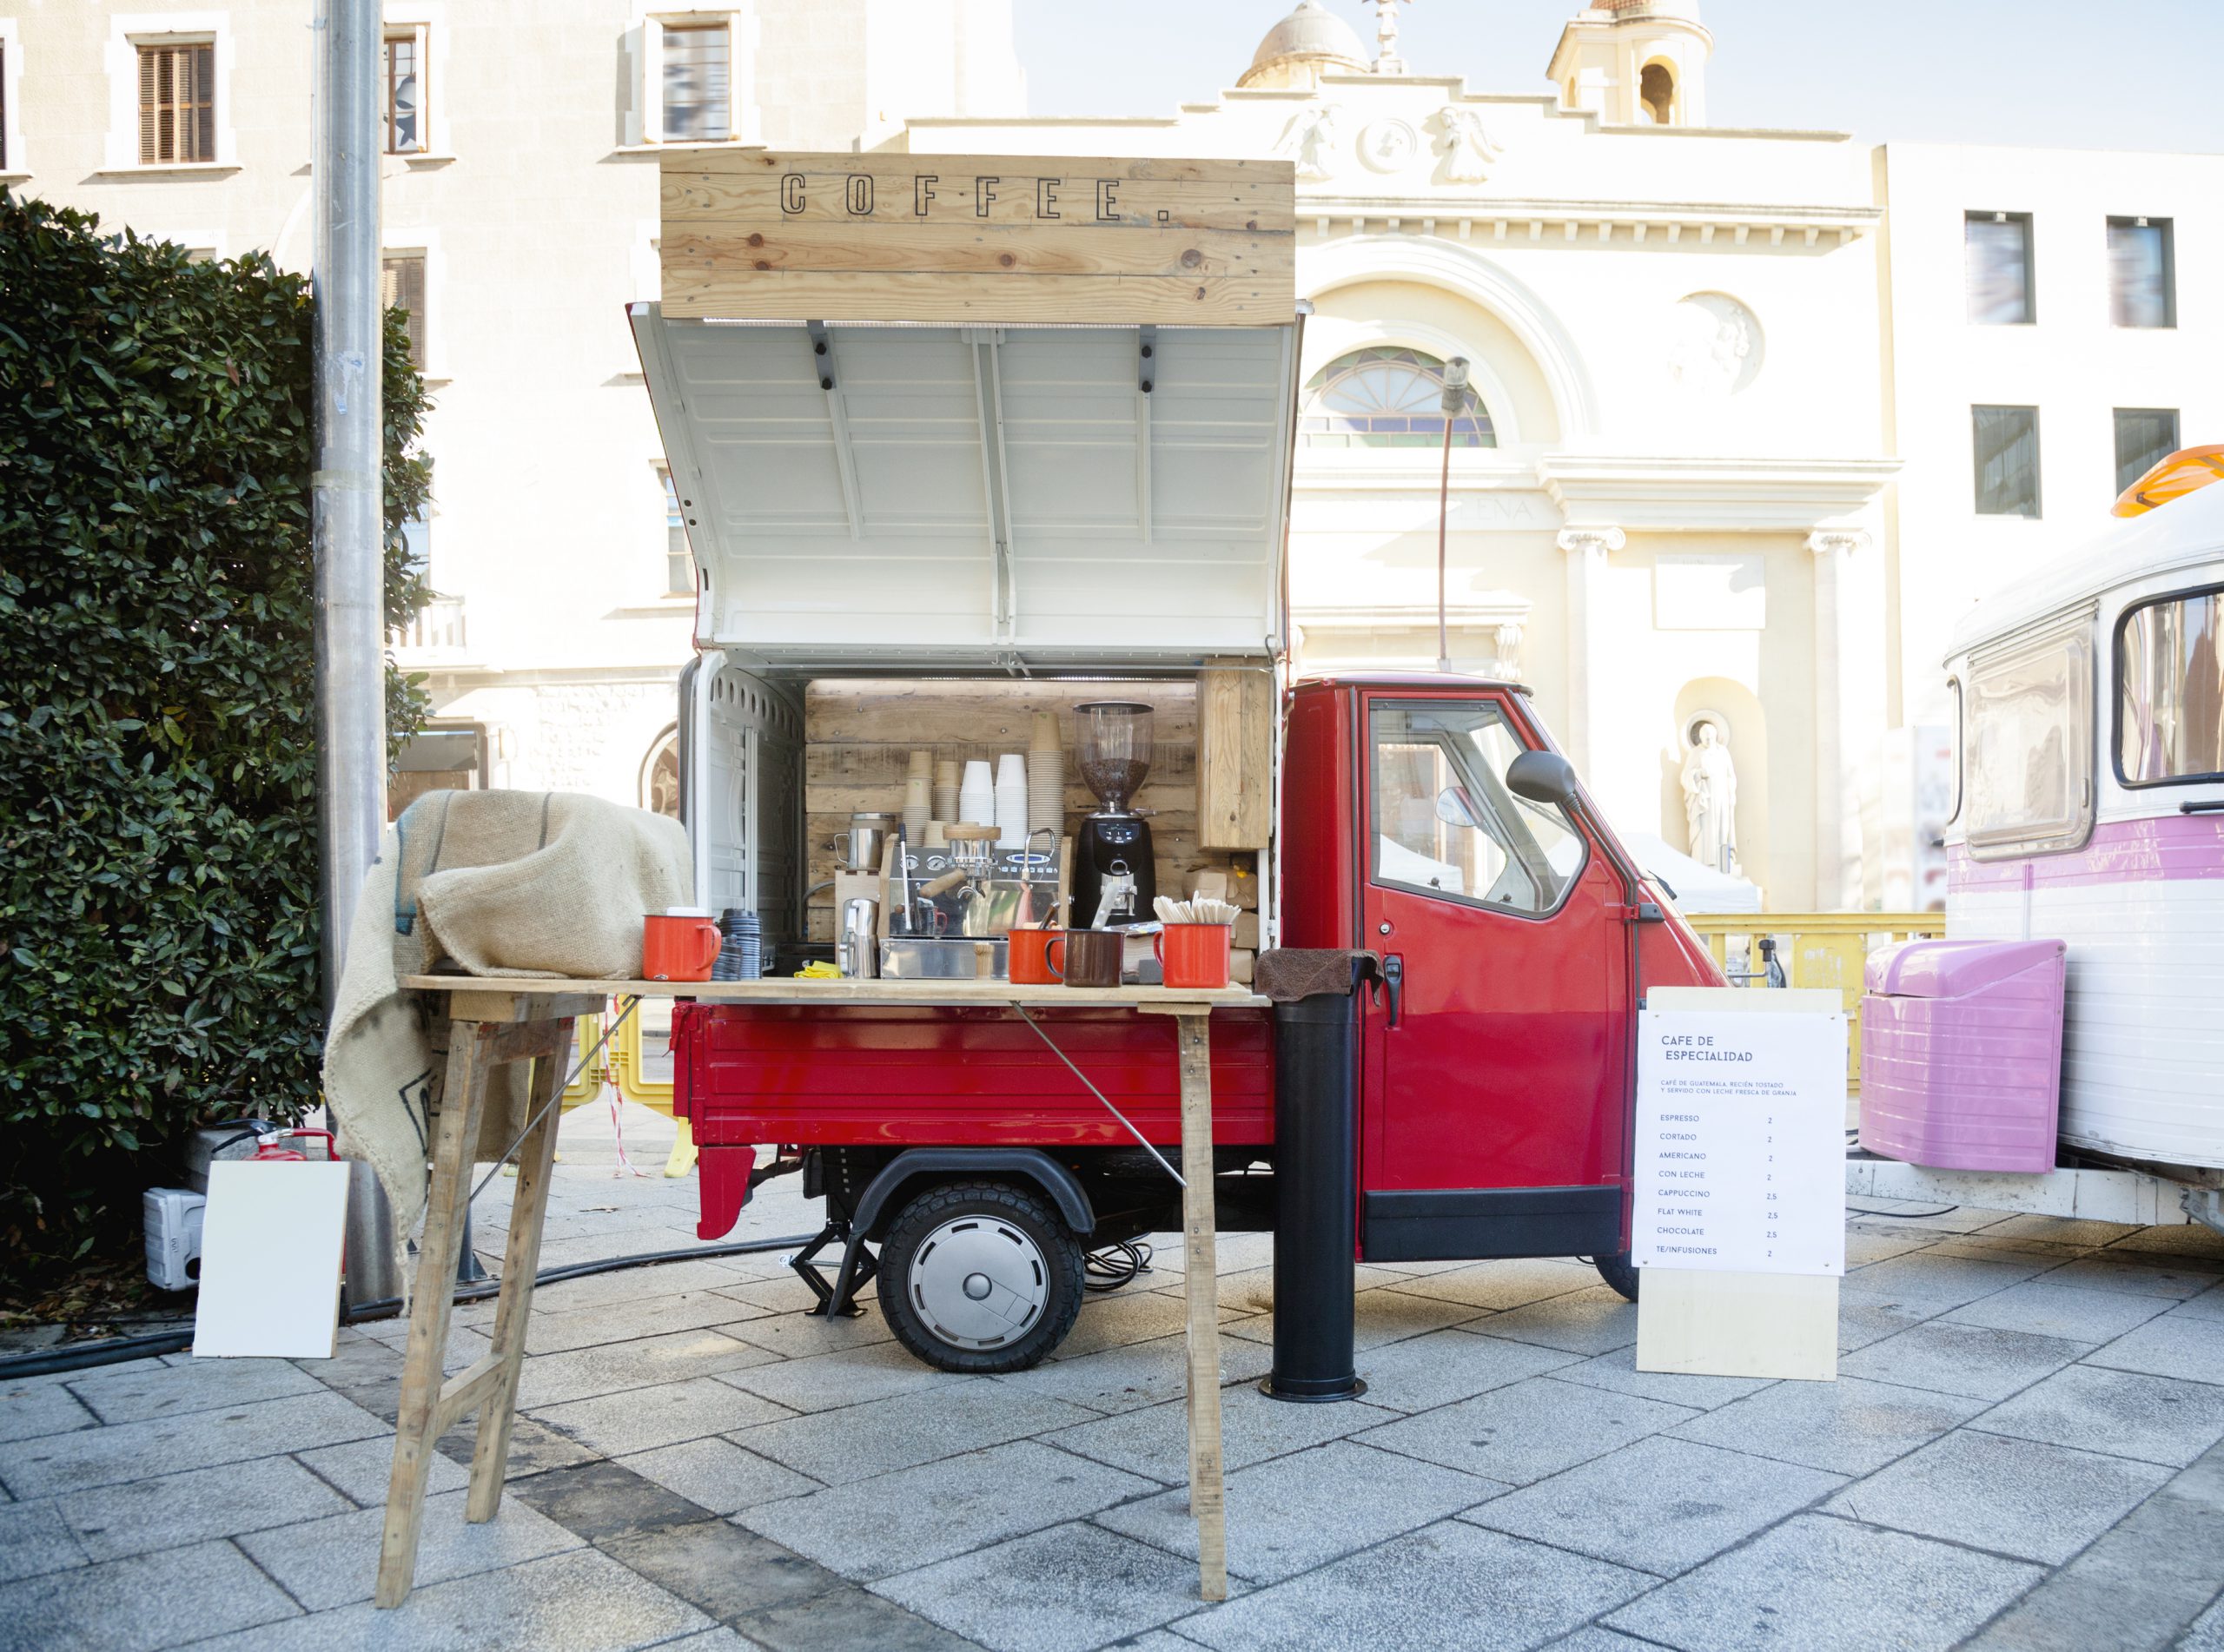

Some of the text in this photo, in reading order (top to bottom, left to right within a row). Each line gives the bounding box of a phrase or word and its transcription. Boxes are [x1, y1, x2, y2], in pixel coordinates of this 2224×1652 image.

[781, 174, 1169, 221] COFFEE.
[1662, 1035, 1713, 1046] CAFE DE
[1666, 1050, 1752, 1061] ESPECIALIDAD
[1658, 1189, 1710, 1198] CAPPUCCINO
[1658, 1226, 1704, 1235] CHOCOLATE
[1656, 1245, 1717, 1254] TE/INFUSIONES
